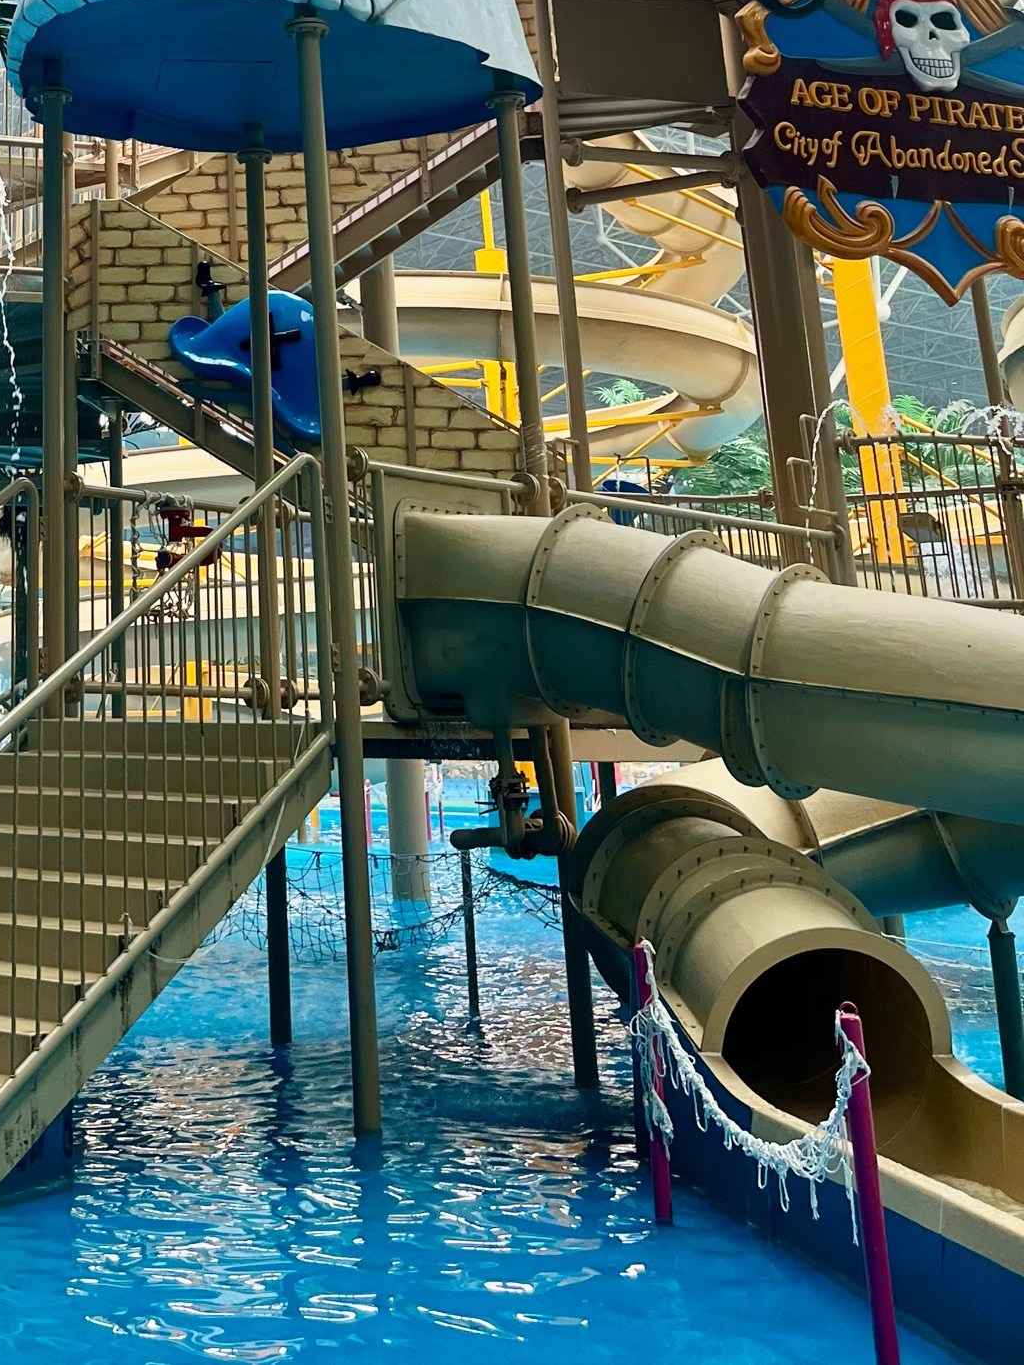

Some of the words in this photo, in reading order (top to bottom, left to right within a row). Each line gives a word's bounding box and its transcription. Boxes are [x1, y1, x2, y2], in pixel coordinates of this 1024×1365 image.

[790, 78, 853, 112] AGE
[858, 87, 901, 118] OF
[906, 93, 1024, 134] PIRATE
[774, 121, 818, 166] City
[821, 130, 843, 168] of
[851, 130, 1009, 178] Abandoned
